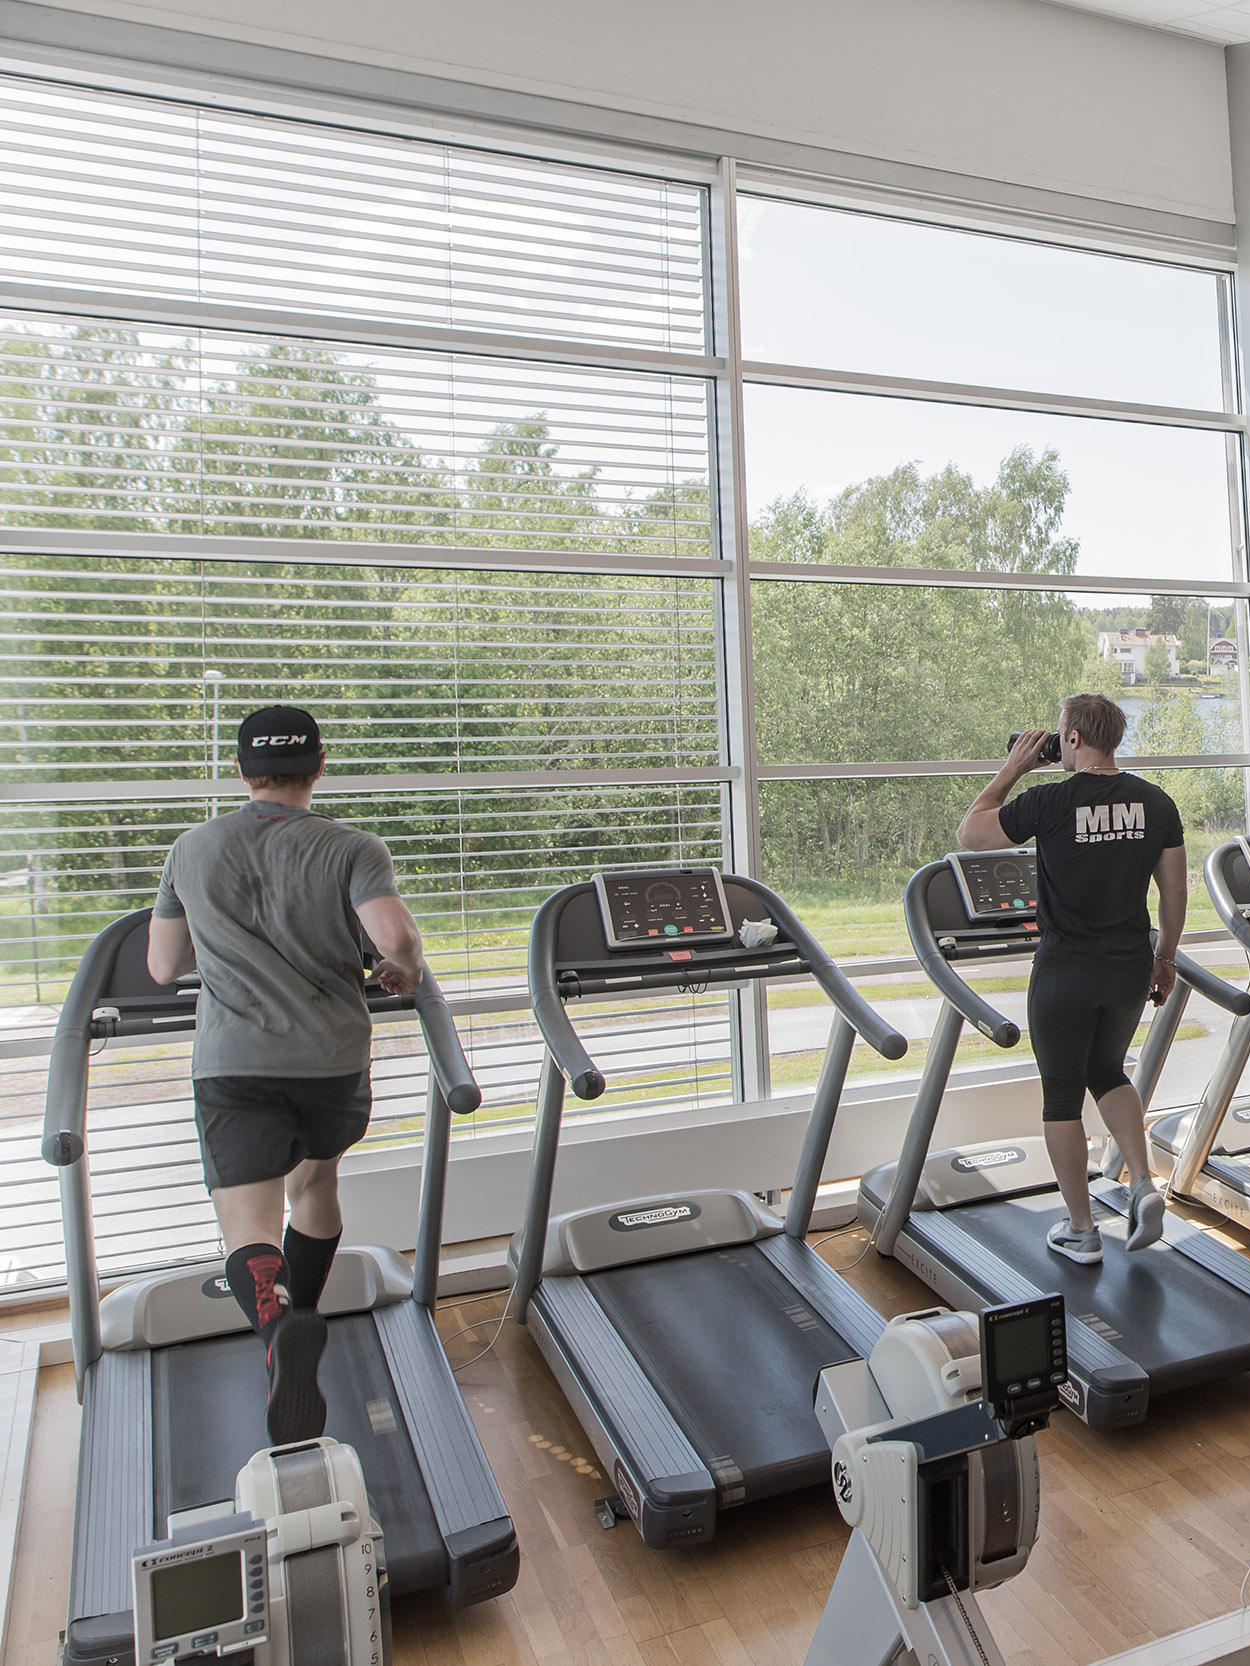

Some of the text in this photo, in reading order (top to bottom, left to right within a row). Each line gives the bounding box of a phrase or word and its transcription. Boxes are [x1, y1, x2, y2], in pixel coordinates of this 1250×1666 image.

[251, 735, 307, 748] CCM
[1075, 802, 1146, 834] MM
[958, 1151, 1018, 1168] TECHNOGYM
[1213, 1192, 1245, 1218] EXCITE
[618, 1206, 691, 1226] TECHNOGYM
[911, 1254, 937, 1285] EXCITE
[361, 1543, 372, 1555] 10
[364, 1563, 372, 1575] 9
[366, 1586, 375, 1598] 8
[367, 1608, 376, 1620] 7
[369, 1630, 378, 1643] 6
[370, 1652, 379, 1665] 5
